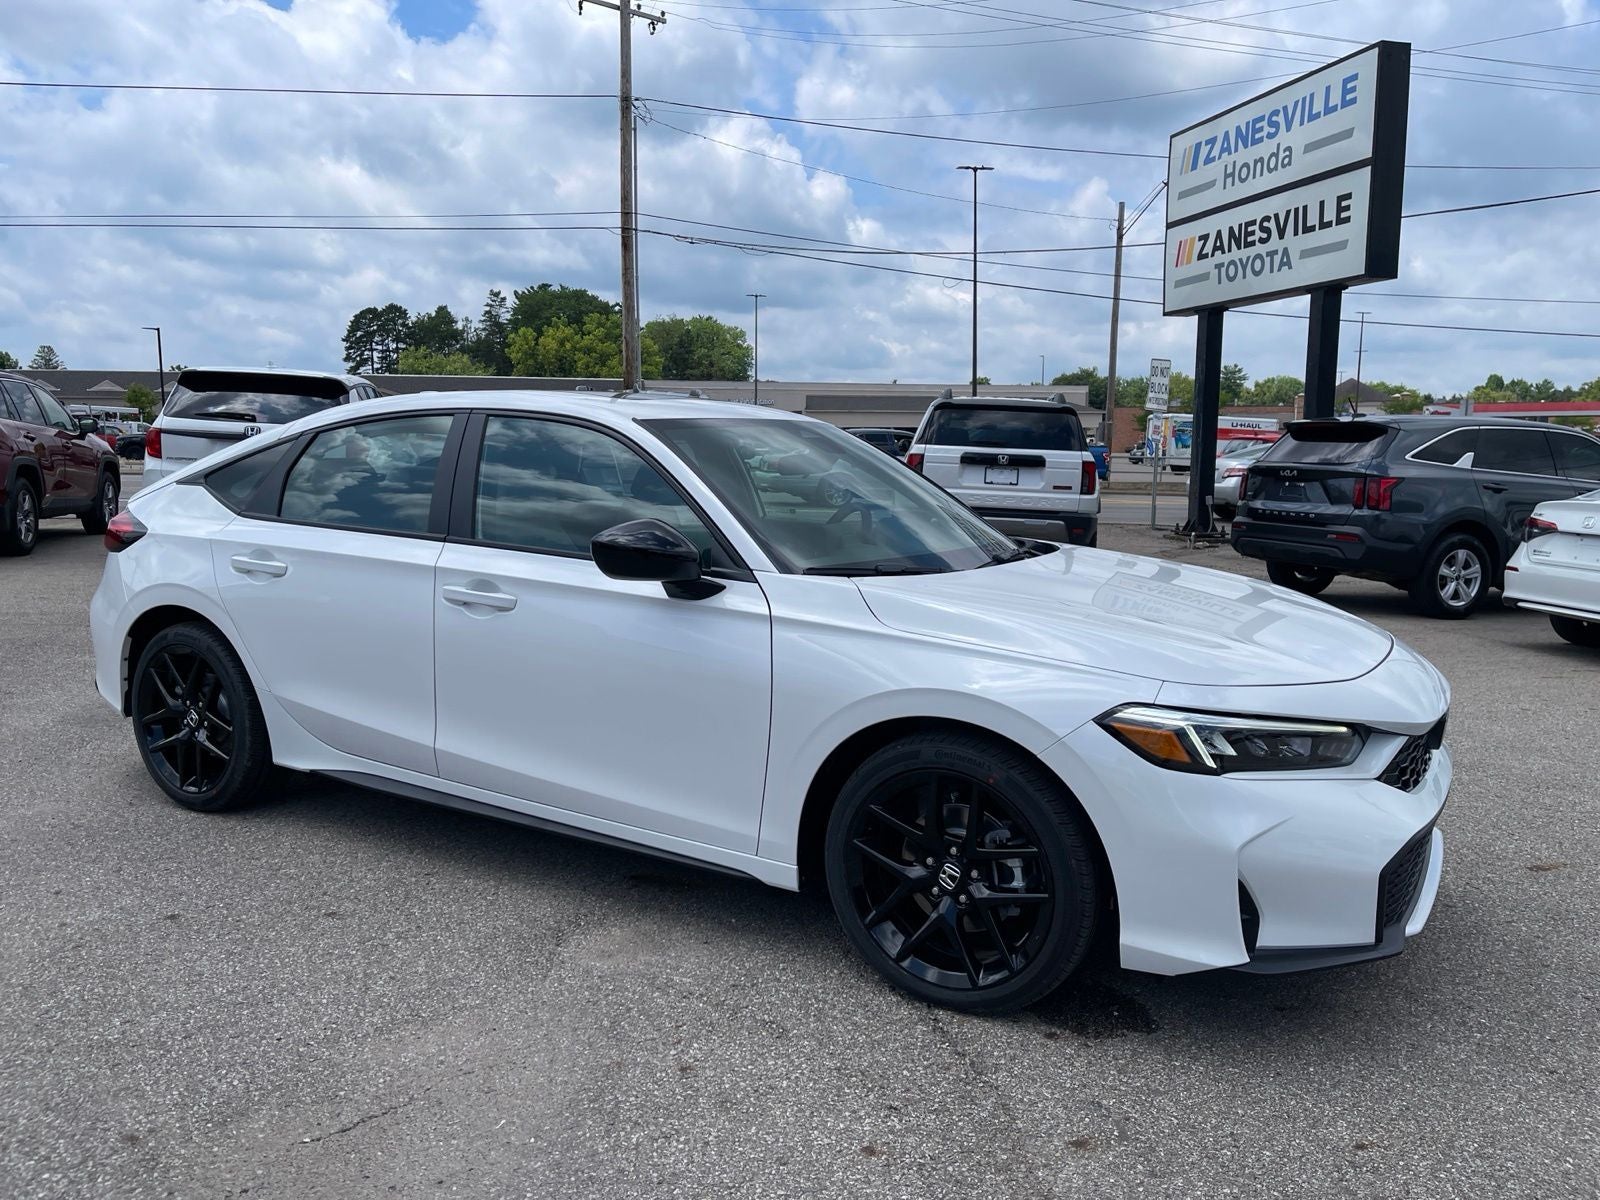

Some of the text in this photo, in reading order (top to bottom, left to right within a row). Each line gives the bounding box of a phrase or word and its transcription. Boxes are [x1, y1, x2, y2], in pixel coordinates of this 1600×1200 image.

[1203, 72, 1359, 167] ZANESVILLE
[1222, 142, 1293, 190] Honda
[1197, 191, 1353, 261] ZANESVILLE
[1214, 246, 1293, 285] TOYOTA
[1150, 381, 1168, 395] BLOCK
[1151, 365, 1170, 379] DO NOT
[967, 495, 1067, 507] SSPORT
